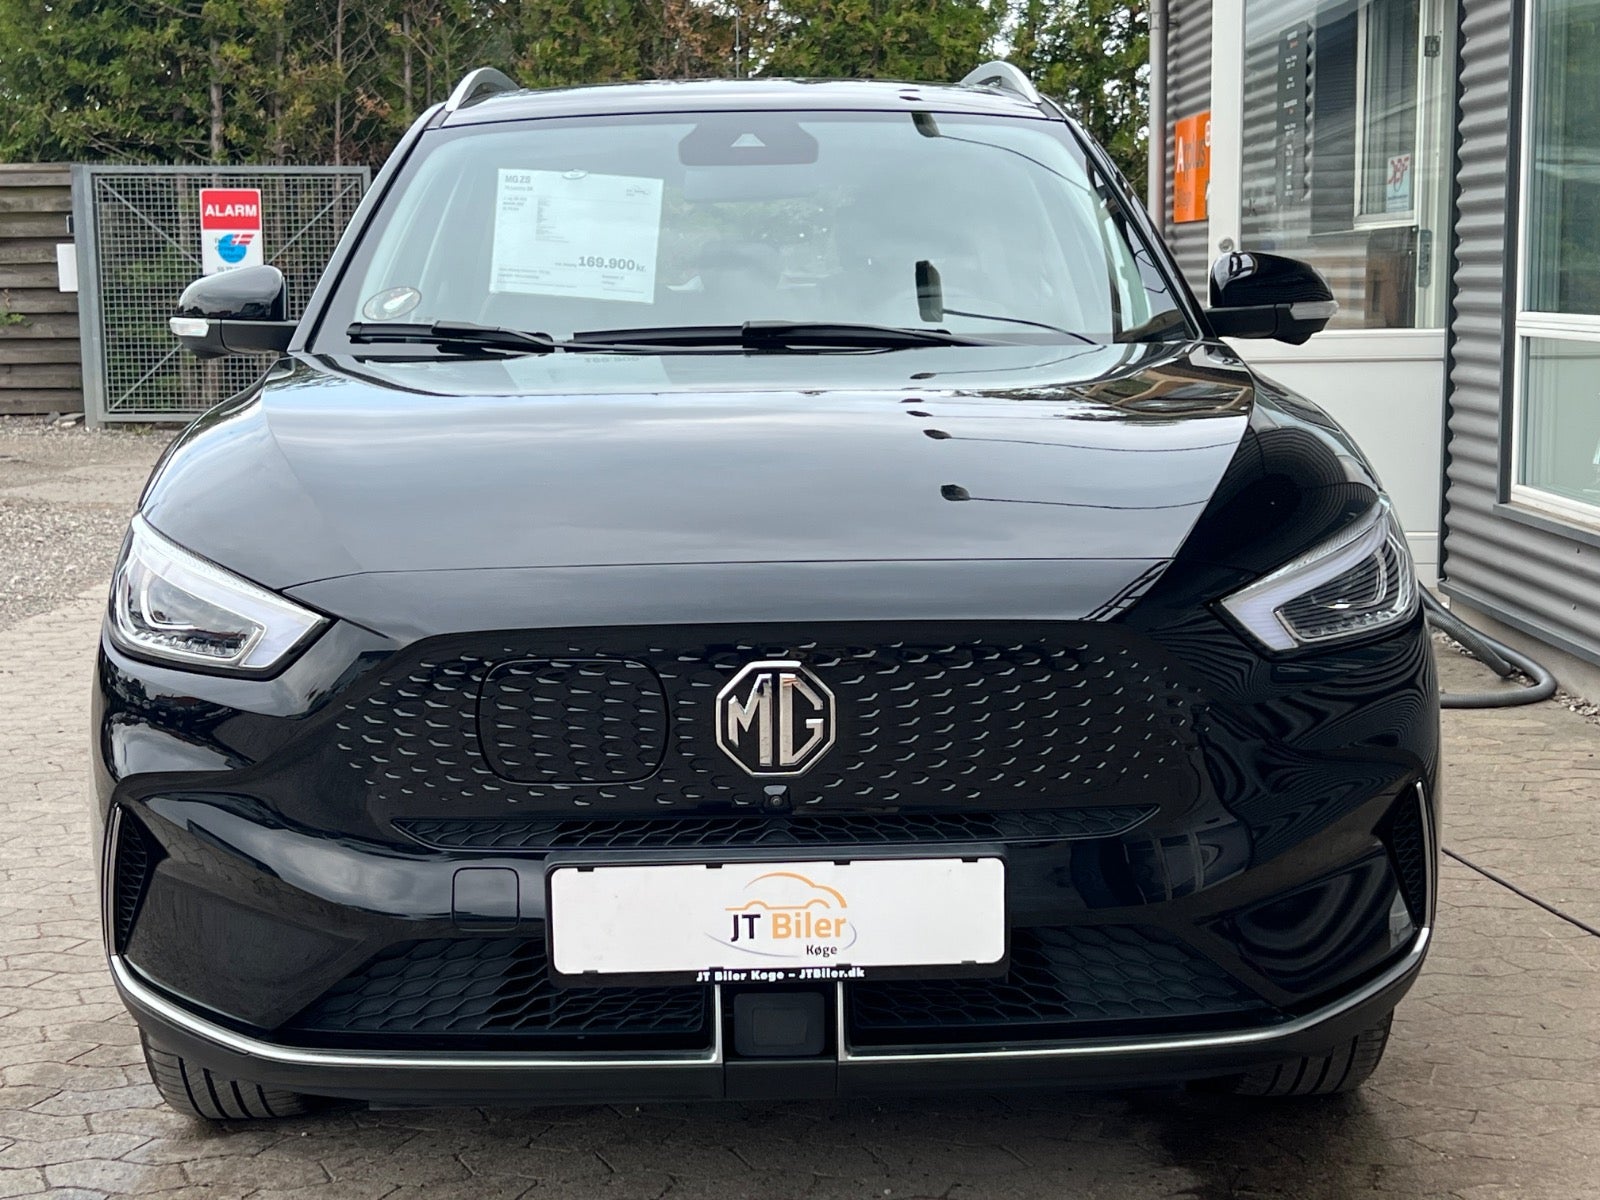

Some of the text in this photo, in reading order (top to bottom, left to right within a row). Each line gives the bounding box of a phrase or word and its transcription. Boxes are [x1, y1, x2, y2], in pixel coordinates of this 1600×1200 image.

[205, 203, 257, 217] ALARM
[578, 256, 635, 270] 169.900
[728, 673, 824, 766] MG
[730, 911, 848, 943] JT Biler
[805, 944, 838, 957] Køge
[695, 970, 711, 982] JT
[714, 970, 746, 981] Biler
[798, 968, 865, 980] JTBiler.dk
